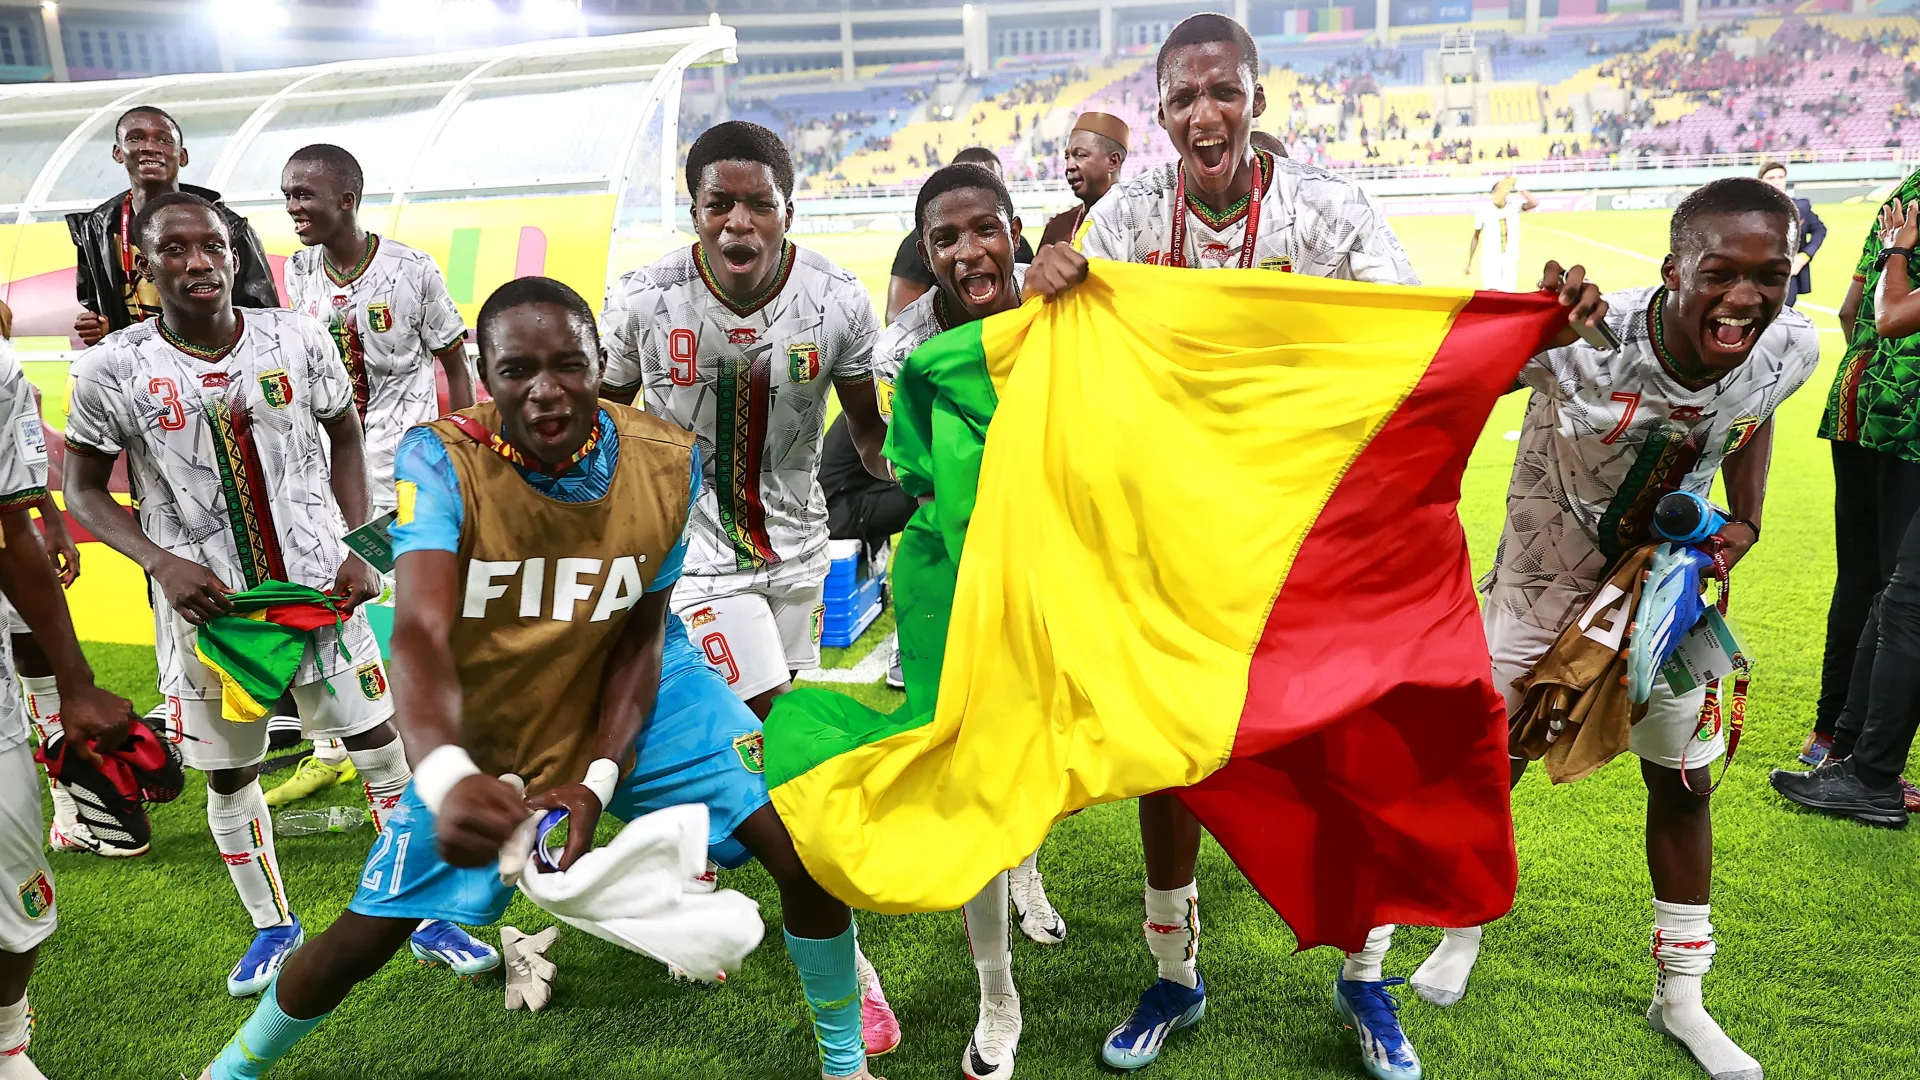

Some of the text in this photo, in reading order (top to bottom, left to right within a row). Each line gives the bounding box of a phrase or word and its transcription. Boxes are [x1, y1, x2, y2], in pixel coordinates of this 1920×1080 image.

[1246, 234, 1254, 248] CUP
[669, 328, 697, 387] 9
[148, 377, 186, 431] 3
[1600, 391, 1642, 446] 7
[462, 555, 643, 623] FIFA
[701, 631, 740, 686] 9
[168, 695, 184, 745] 3
[361, 825, 412, 896] 21
